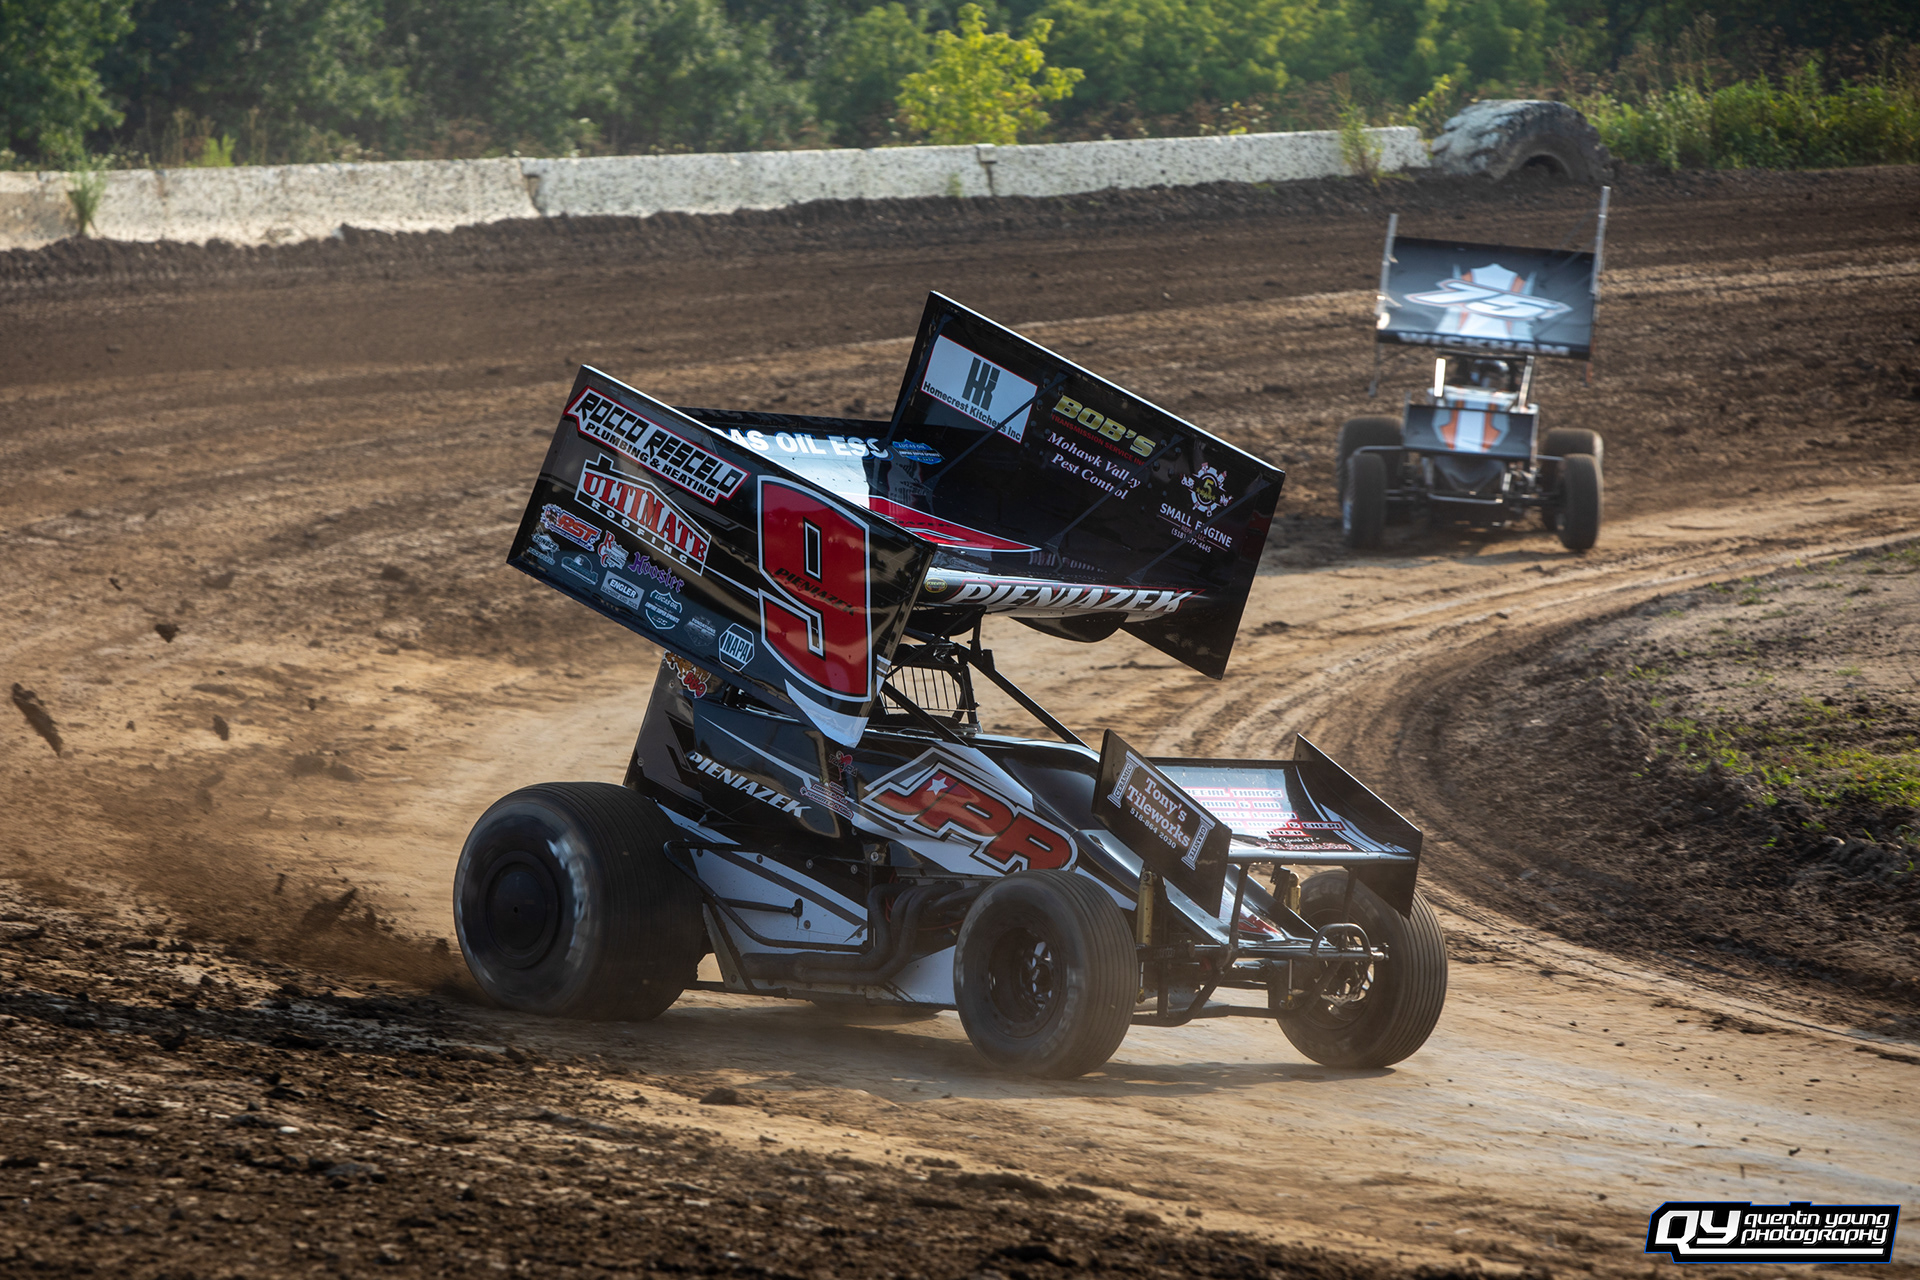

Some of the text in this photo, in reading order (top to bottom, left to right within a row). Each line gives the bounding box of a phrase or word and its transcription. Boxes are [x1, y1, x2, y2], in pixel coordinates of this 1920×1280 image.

[923, 381, 969, 413] Homecrest
[1007, 426, 1021, 441] Inc
[1053, 394, 1156, 458] BOB'S
[575, 392, 744, 494] ROCCO RESCELO
[775, 431, 826, 456] OIL
[828, 435, 892, 461] ESS
[1047, 432, 1103, 467] Mohawk
[1051, 414, 1104, 446] TRANSMISSION
[1104, 441, 1133, 462] SERVICE
[585, 422, 717, 500] PLUMBING & HEATING
[1051, 453, 1079, 475] Pest
[1204, 479, 1215, 497] 5
[583, 472, 708, 563] ULTIMATE
[590, 500, 688, 564] ROOFING
[1160, 503, 1232, 548] SMALL ENGINE
[533, 533, 558, 551] SUNOCO
[609, 578, 637, 599] ENGLER
[628, 551, 685, 594] Hoosier
[757, 474, 872, 701] 9
[774, 567, 860, 617] PIENIAZEK
[655, 594, 669, 606] LUCAS
[669, 601, 679, 611] OIL
[946, 582, 1193, 613] PIENIAZEK
[723, 633, 750, 664] NAPA
[684, 672, 706, 697] BBQ
[687, 751, 813, 818] PIENIAZEK
[1114, 763, 1134, 798] CERAMIC
[1145, 777, 1188, 823] Tony's
[1127, 784, 1191, 847] Tileworks
[1130, 807, 1177, 849] 518-864 2030
[1189, 824, 1206, 860] GRANITE
